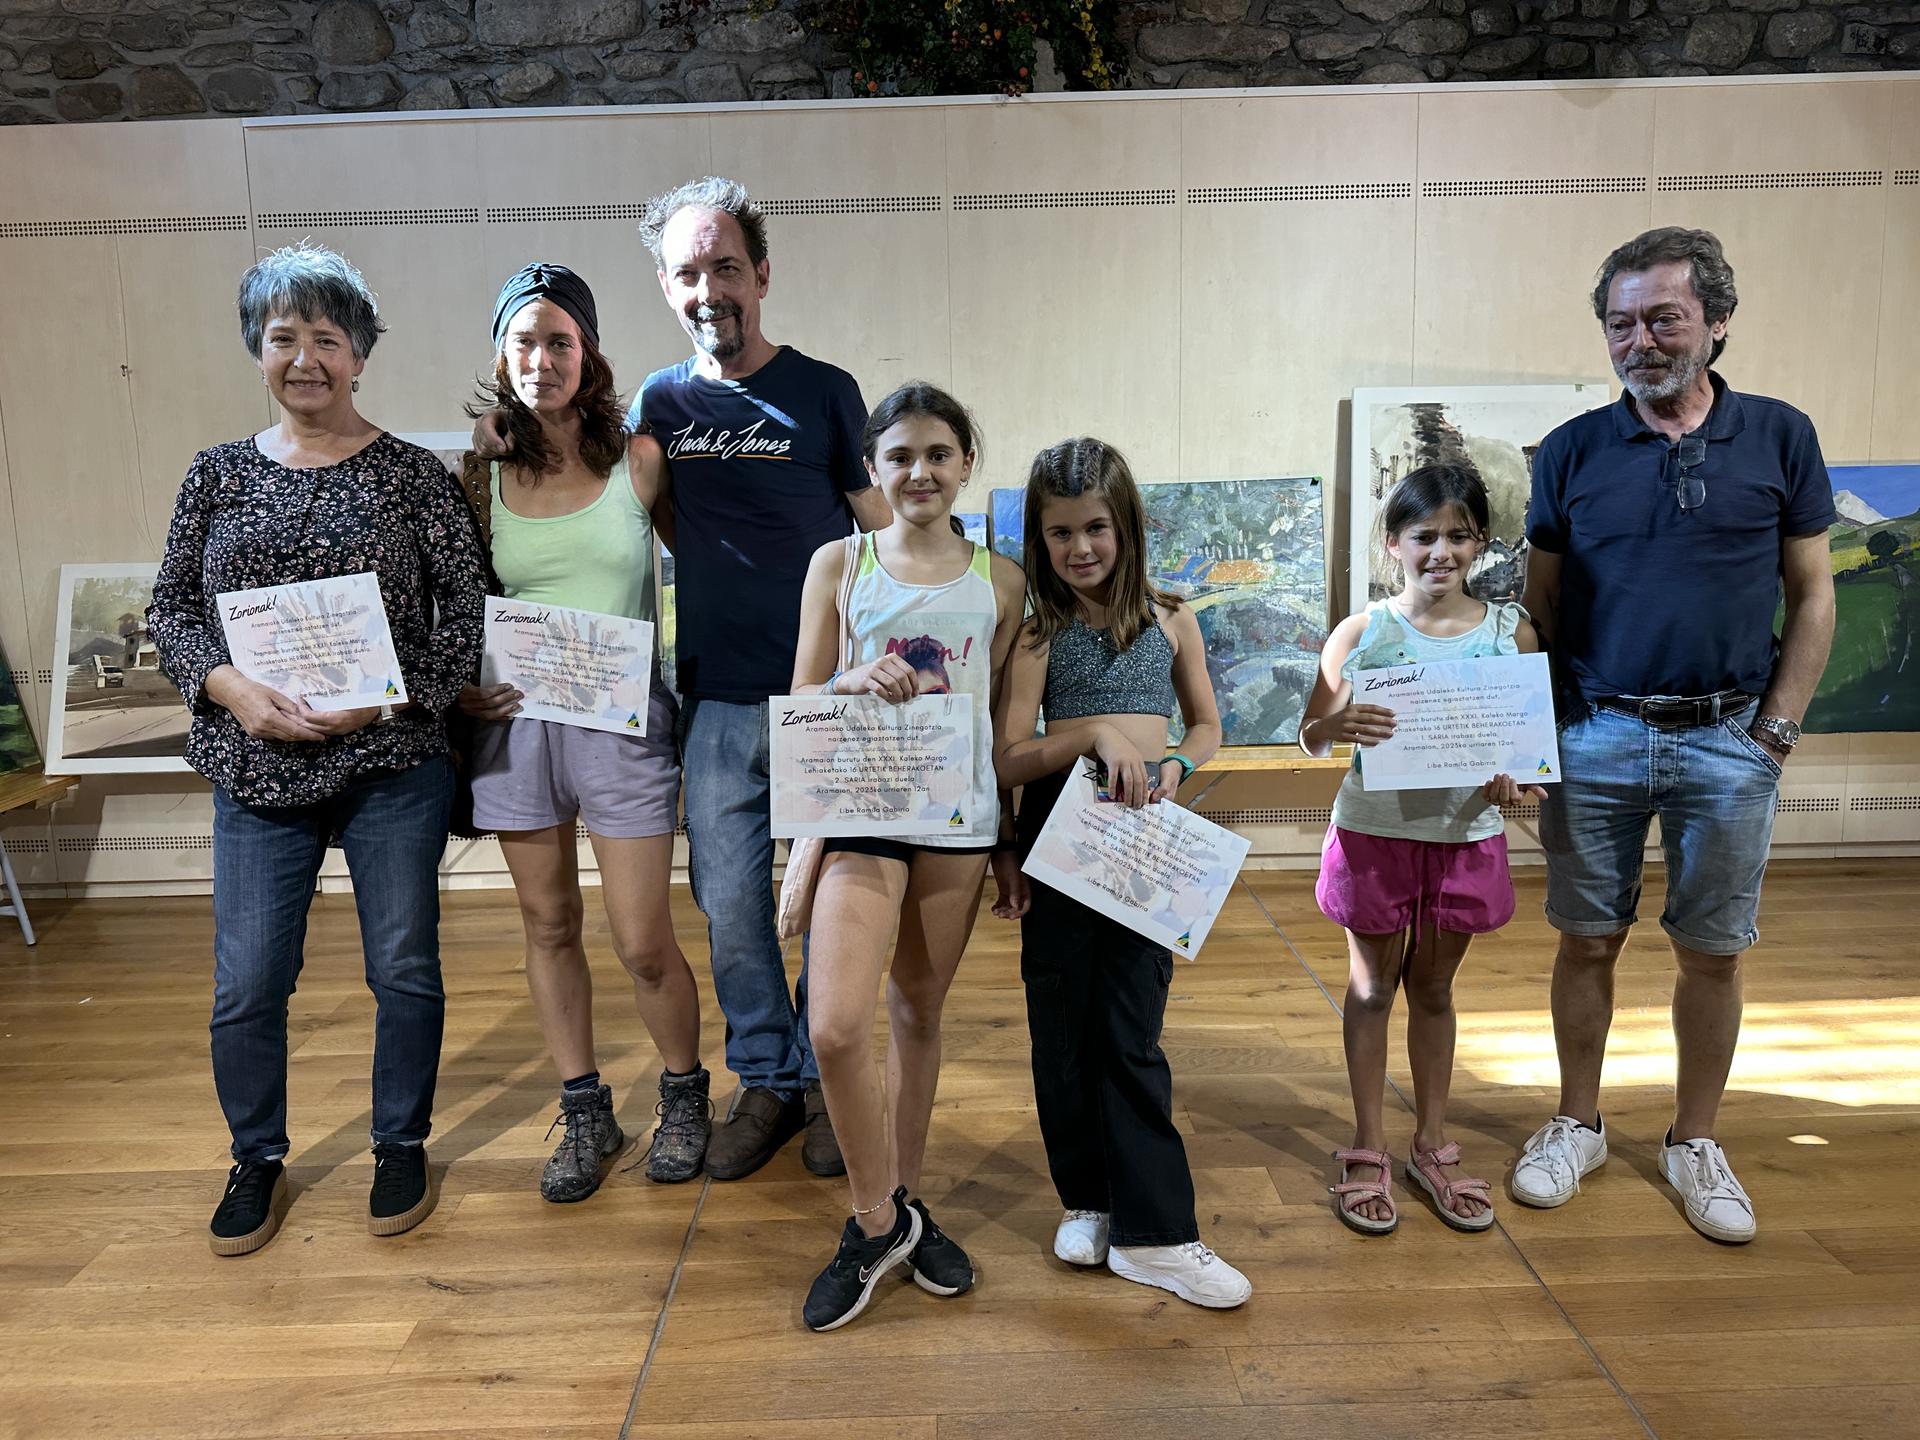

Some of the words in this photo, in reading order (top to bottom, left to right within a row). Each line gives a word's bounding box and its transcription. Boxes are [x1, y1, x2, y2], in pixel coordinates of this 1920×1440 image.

[667, 420, 713, 459] Jack
[710, 430, 731, 452] &
[721, 418, 791, 460] Jones
[229, 594, 277, 621] Zorionak!
[494, 610, 550, 624] Zorionak!
[1365, 667, 1425, 691] Zorionak!
[781, 703, 848, 726] Zorionak!
[846, 724, 875, 732] Udaleko
[904, 724, 942, 733] Zinegotzia
[1394, 725, 1431, 733] ehiaketako
[1472, 720, 1526, 729] BEHERAKOETAN
[827, 735, 859, 743] naizenez
[862, 735, 905, 744] egiaztatzen
[924, 755, 948, 763] Margo
[804, 766, 847, 774] Lehiaketako
[1082, 808, 1112, 826] Aramaion
[1113, 822, 1133, 837] burutu
[1134, 835, 1146, 844] den
[1166, 850, 1186, 865] Kaleko
[1188, 862, 1208, 876] Margo
[1183, 827, 1216, 848] Zinegotzia
[1081, 818, 1118, 840] Lehiaketako
[1126, 841, 1151, 857] URTETIK
[1152, 854, 1200, 884] BEHERAKOETAN
[1109, 844, 1128, 857] SARIA
[1129, 855, 1151, 870] irabazi
[1087, 876, 1100, 887] Libe
